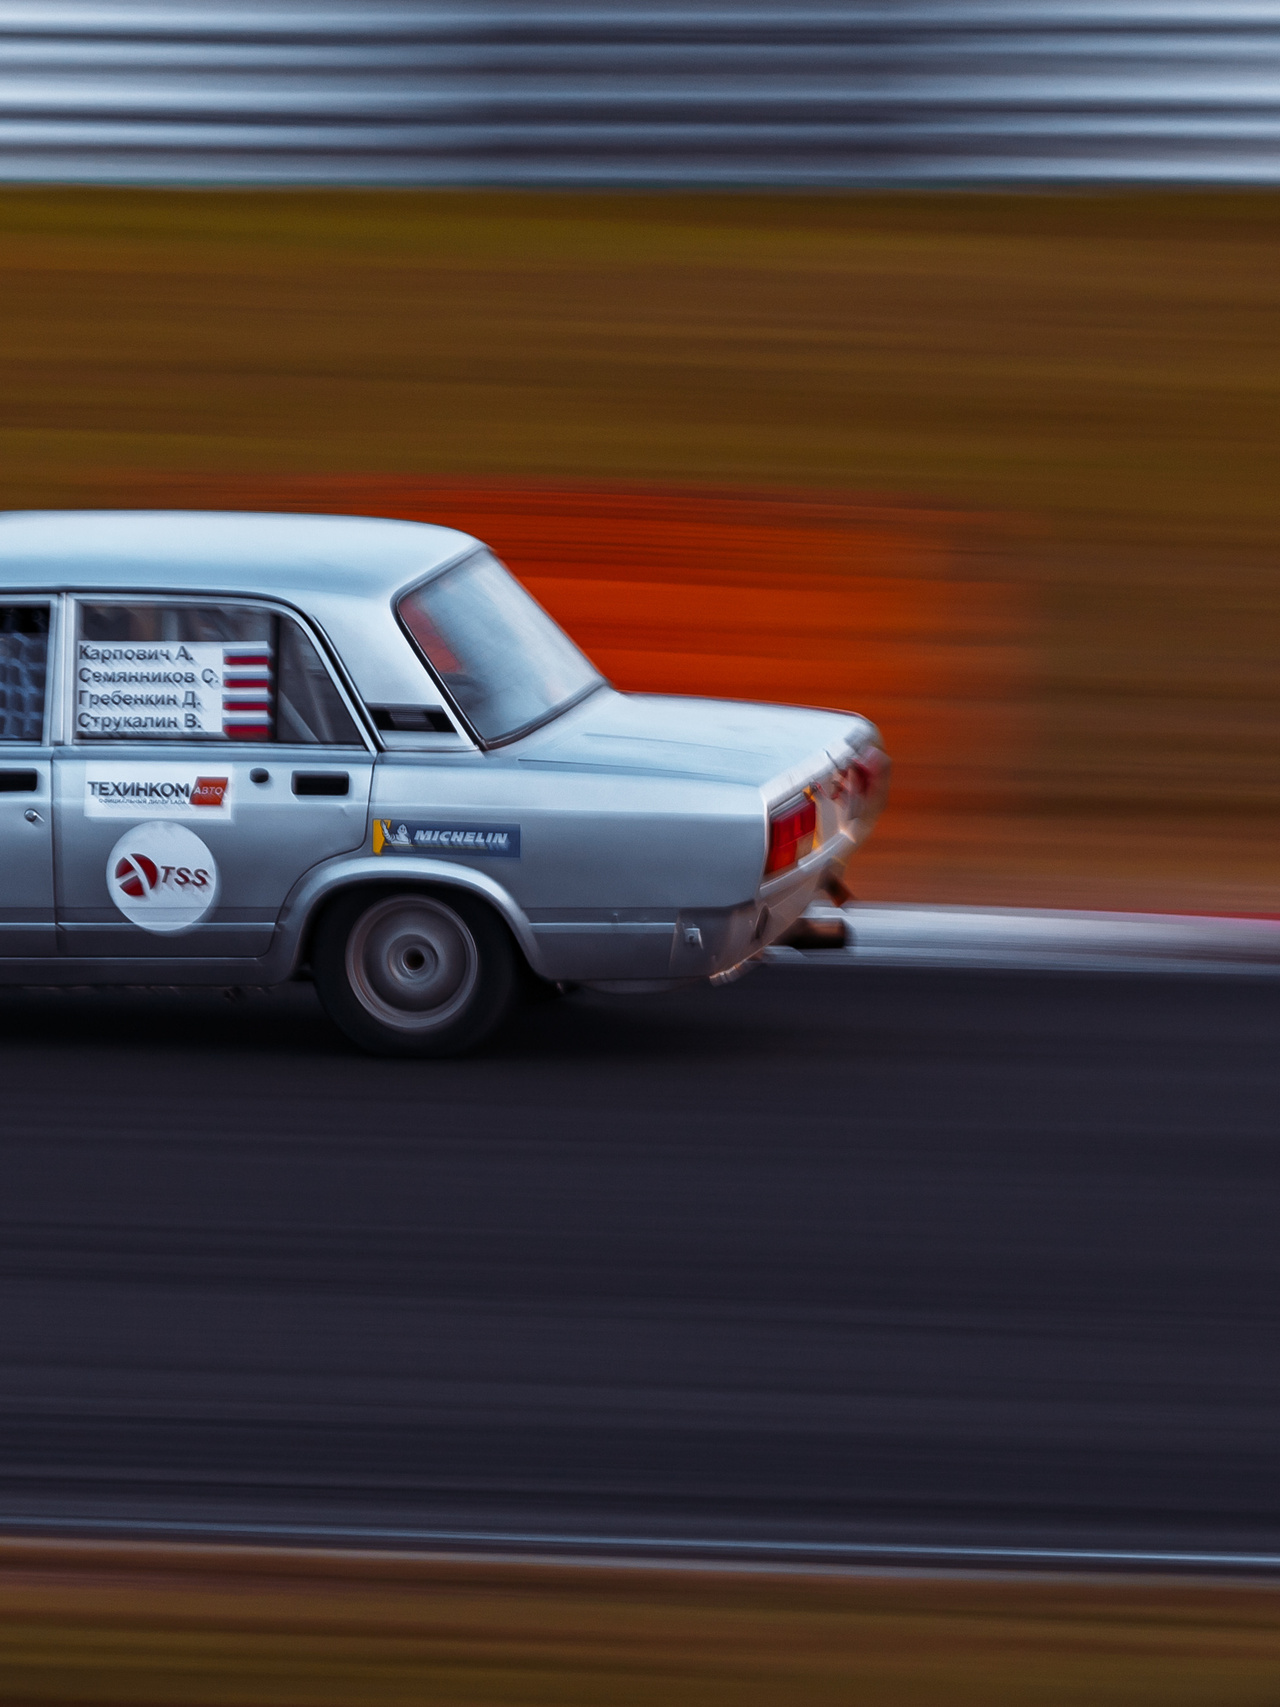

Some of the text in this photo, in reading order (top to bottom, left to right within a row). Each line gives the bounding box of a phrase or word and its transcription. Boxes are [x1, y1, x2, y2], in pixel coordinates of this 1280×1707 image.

[79, 645, 194, 662] Карпович А.
[79, 667, 219, 684] Семянников С.
[79, 690, 201, 708] Гребенкин Д.
[78, 713, 202, 731] Струкалин В.
[87, 781, 223, 798] ТЕХИНКОМ АВТО
[414, 830, 508, 844] MICHELIN
[160, 865, 208, 887] TSS
